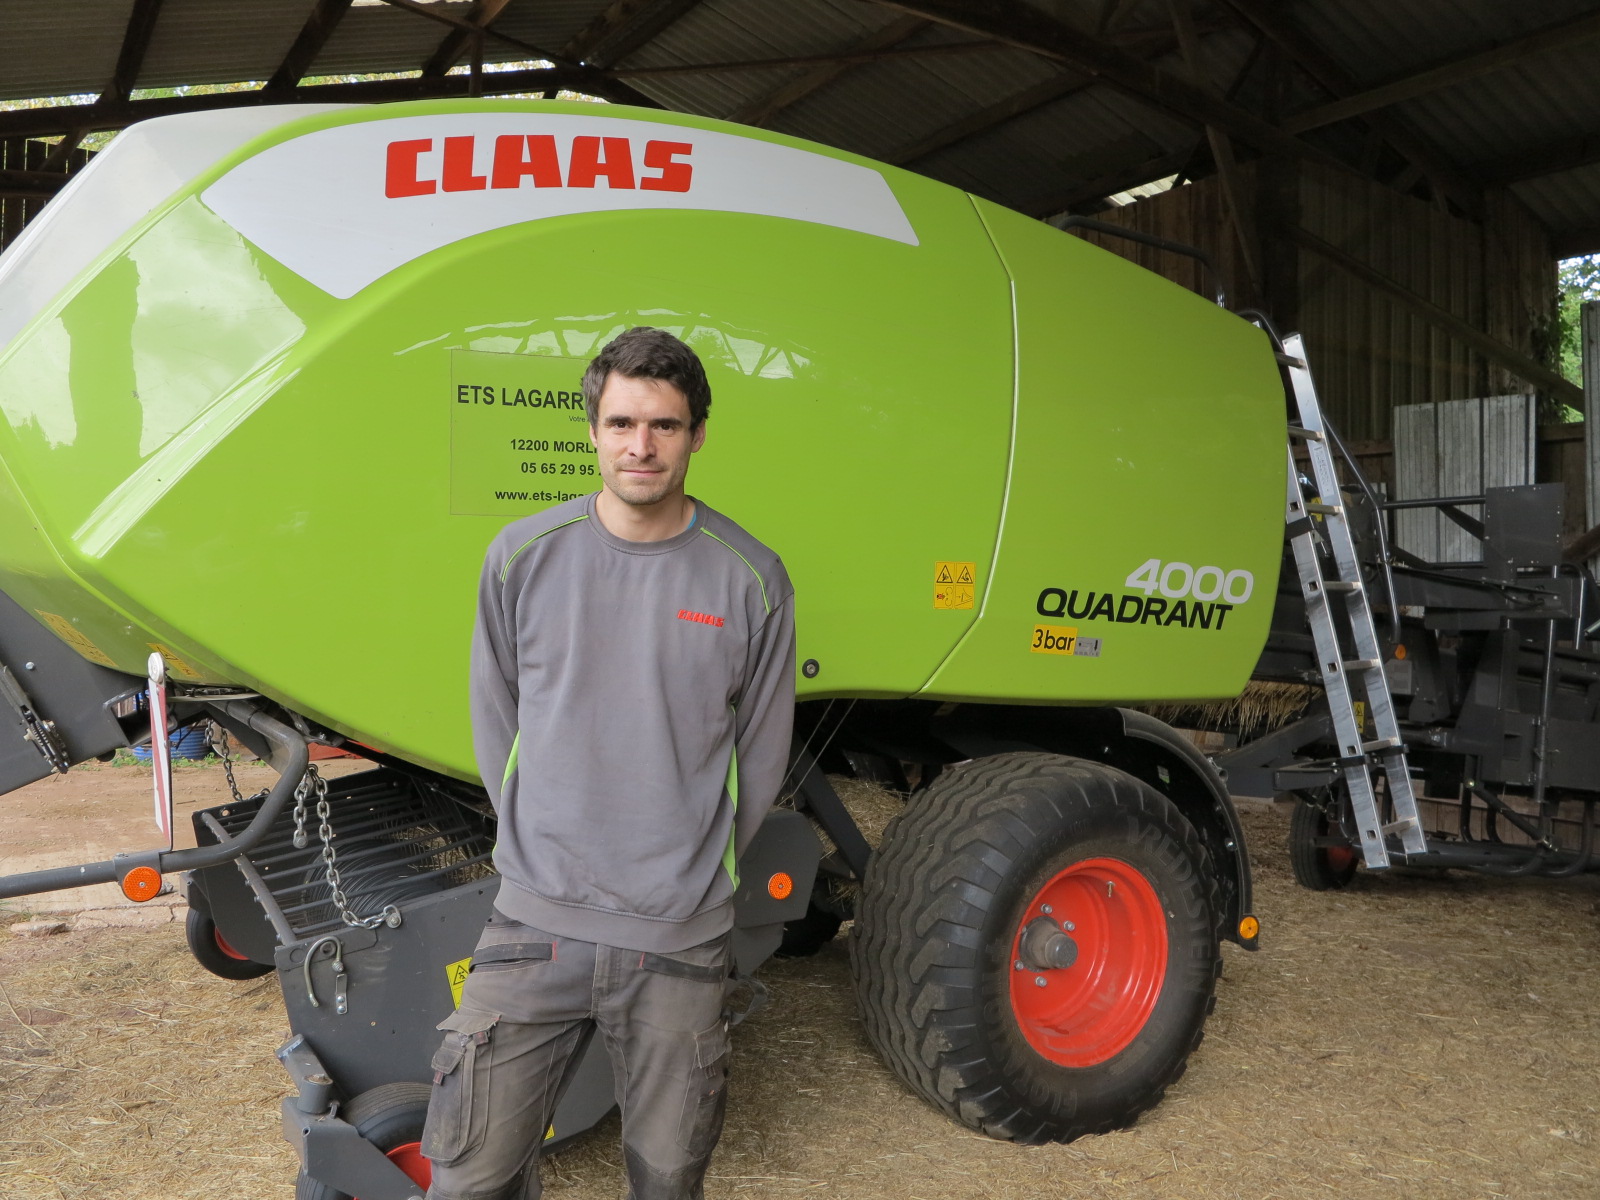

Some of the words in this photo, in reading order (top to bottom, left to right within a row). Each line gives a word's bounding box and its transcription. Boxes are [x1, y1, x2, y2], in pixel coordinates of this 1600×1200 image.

[385, 134, 693, 199] CLAAS
[457, 384, 495, 405] ETS
[502, 388, 585, 410] LAGARR
[568, 415, 586, 423] Votre
[510, 438, 549, 452] 12200
[521, 461, 537, 474] 05
[540, 462, 557, 475] 65
[560, 463, 576, 475] 29
[579, 464, 595, 476] 95
[495, 490, 588, 502] www.ets-lag
[1125, 558, 1254, 604] 4000
[1036, 587, 1233, 630] QUADRANT
